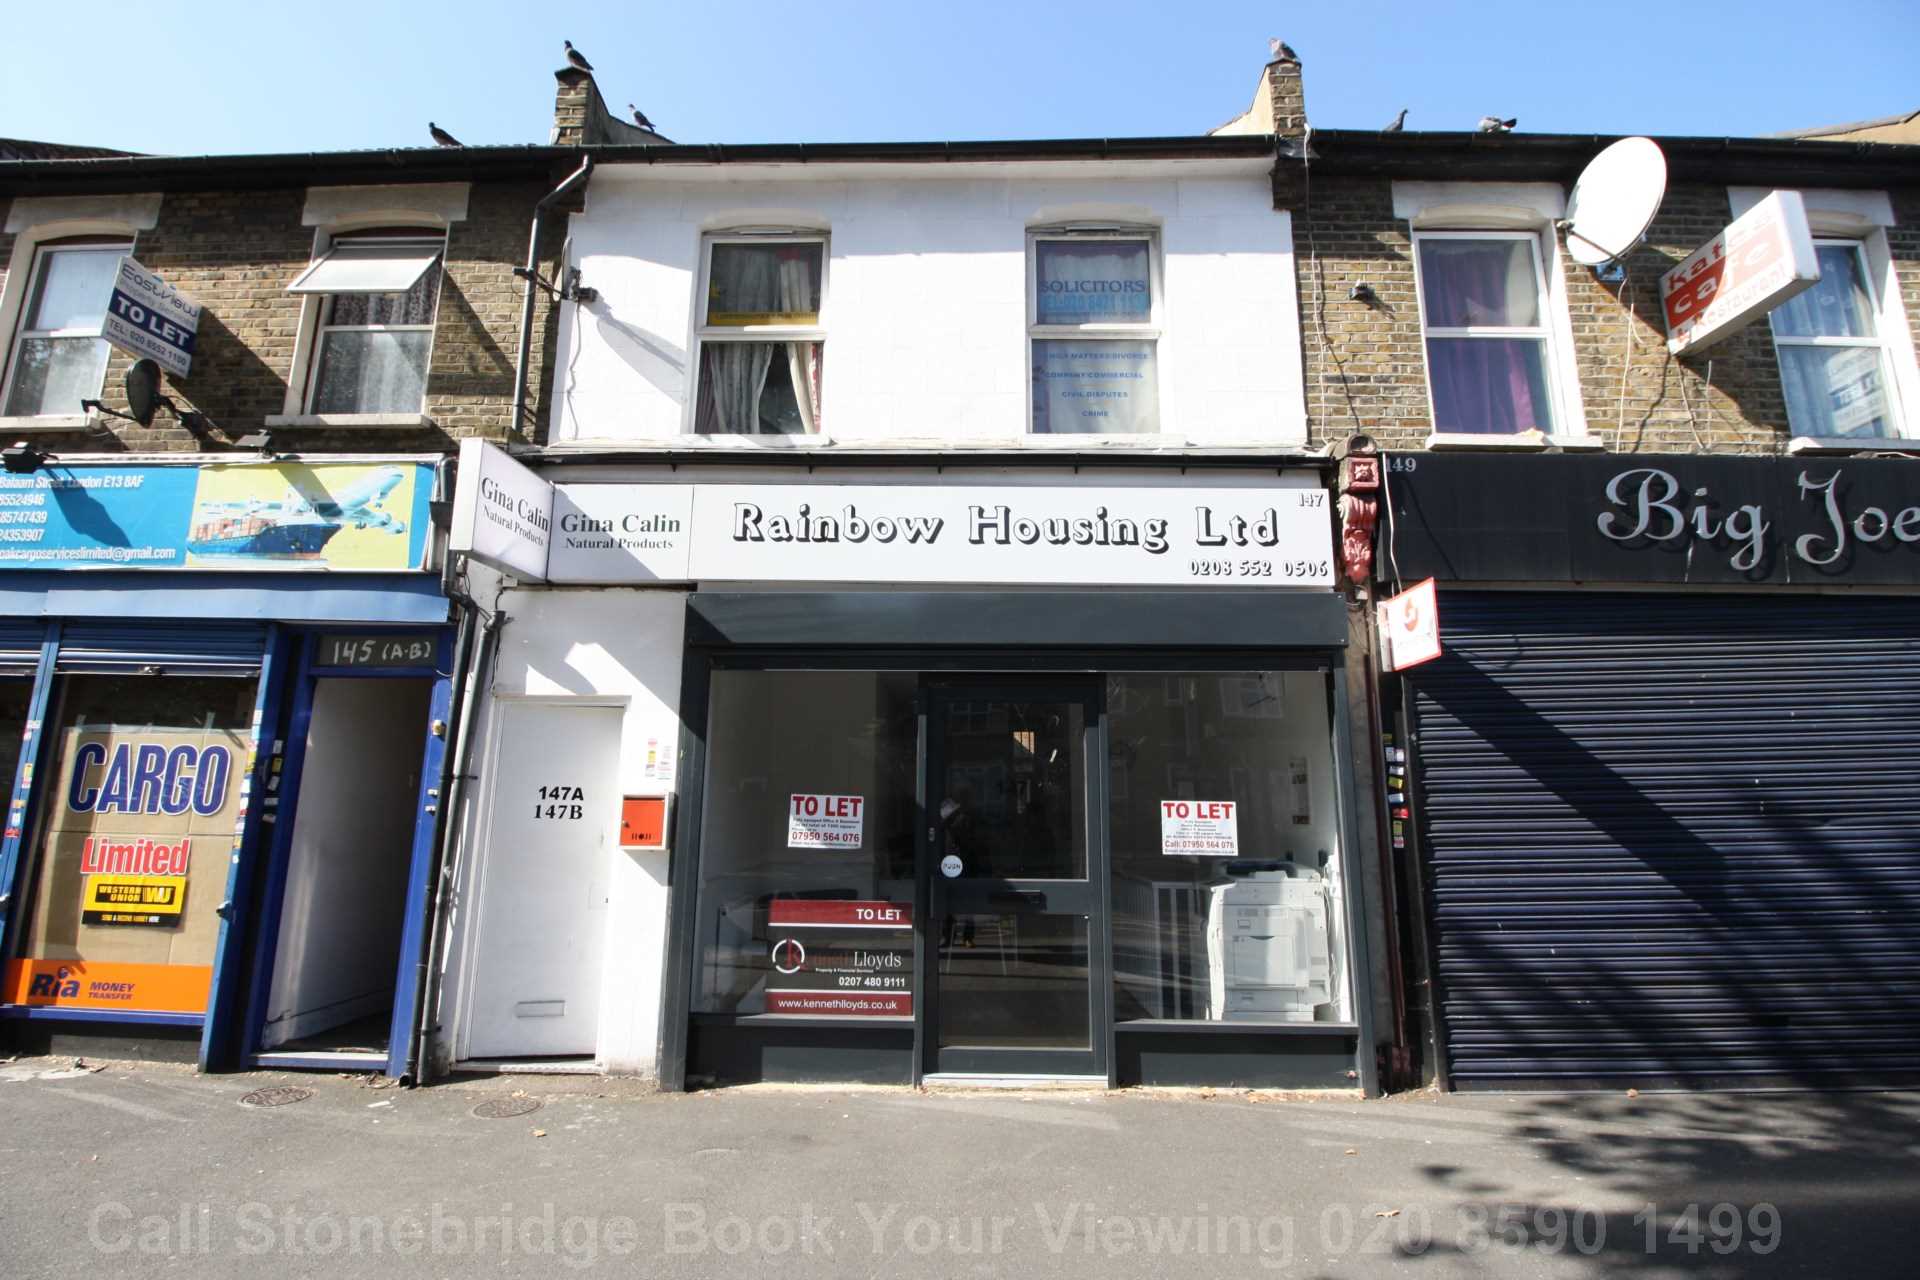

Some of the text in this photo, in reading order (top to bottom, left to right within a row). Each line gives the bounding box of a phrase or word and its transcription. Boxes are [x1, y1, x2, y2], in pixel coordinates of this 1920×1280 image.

[1039, 280, 1146, 294] SOLICITORS
[117, 296, 146, 324] TO
[149, 316, 190, 347] LET
[1386, 457, 1417, 473] 149
[104, 475, 122, 488] E13
[124, 475, 144, 487] 8AF
[481, 476, 549, 533] Gina Calin
[1298, 493, 1325, 508] 147
[483, 504, 544, 547] Natural Products
[560, 514, 682, 533] Gina Calin
[1597, 468, 1771, 571] Big
[733, 502, 1279, 555] Rainbow Housing Ltd
[566, 537, 673, 550] Natural Products
[1188, 559, 1329, 579] 0208 552 0506
[333, 640, 377, 664] 145
[66, 742, 232, 816] CARGO
[538, 786, 584, 801] 147A
[534, 804, 583, 820] 147B
[792, 796, 862, 817] TO LET
[1162, 803, 1233, 820] TO LET
[792, 831, 860, 842] 07950 564 076
[80, 836, 191, 877] Limited
[99, 885, 143, 894] WESTERN
[110, 893, 141, 902] UNION
[856, 908, 903, 921] TO LET
[854, 951, 903, 970] Lloyds
[30, 966, 81, 998] Ria
[90, 981, 136, 993] MONEY
[838, 976, 905, 988] 0207 480 9111
[88, 992, 133, 1001] TRANSFER
[778, 999, 898, 1012] www.kennethlloyds.co.uk
